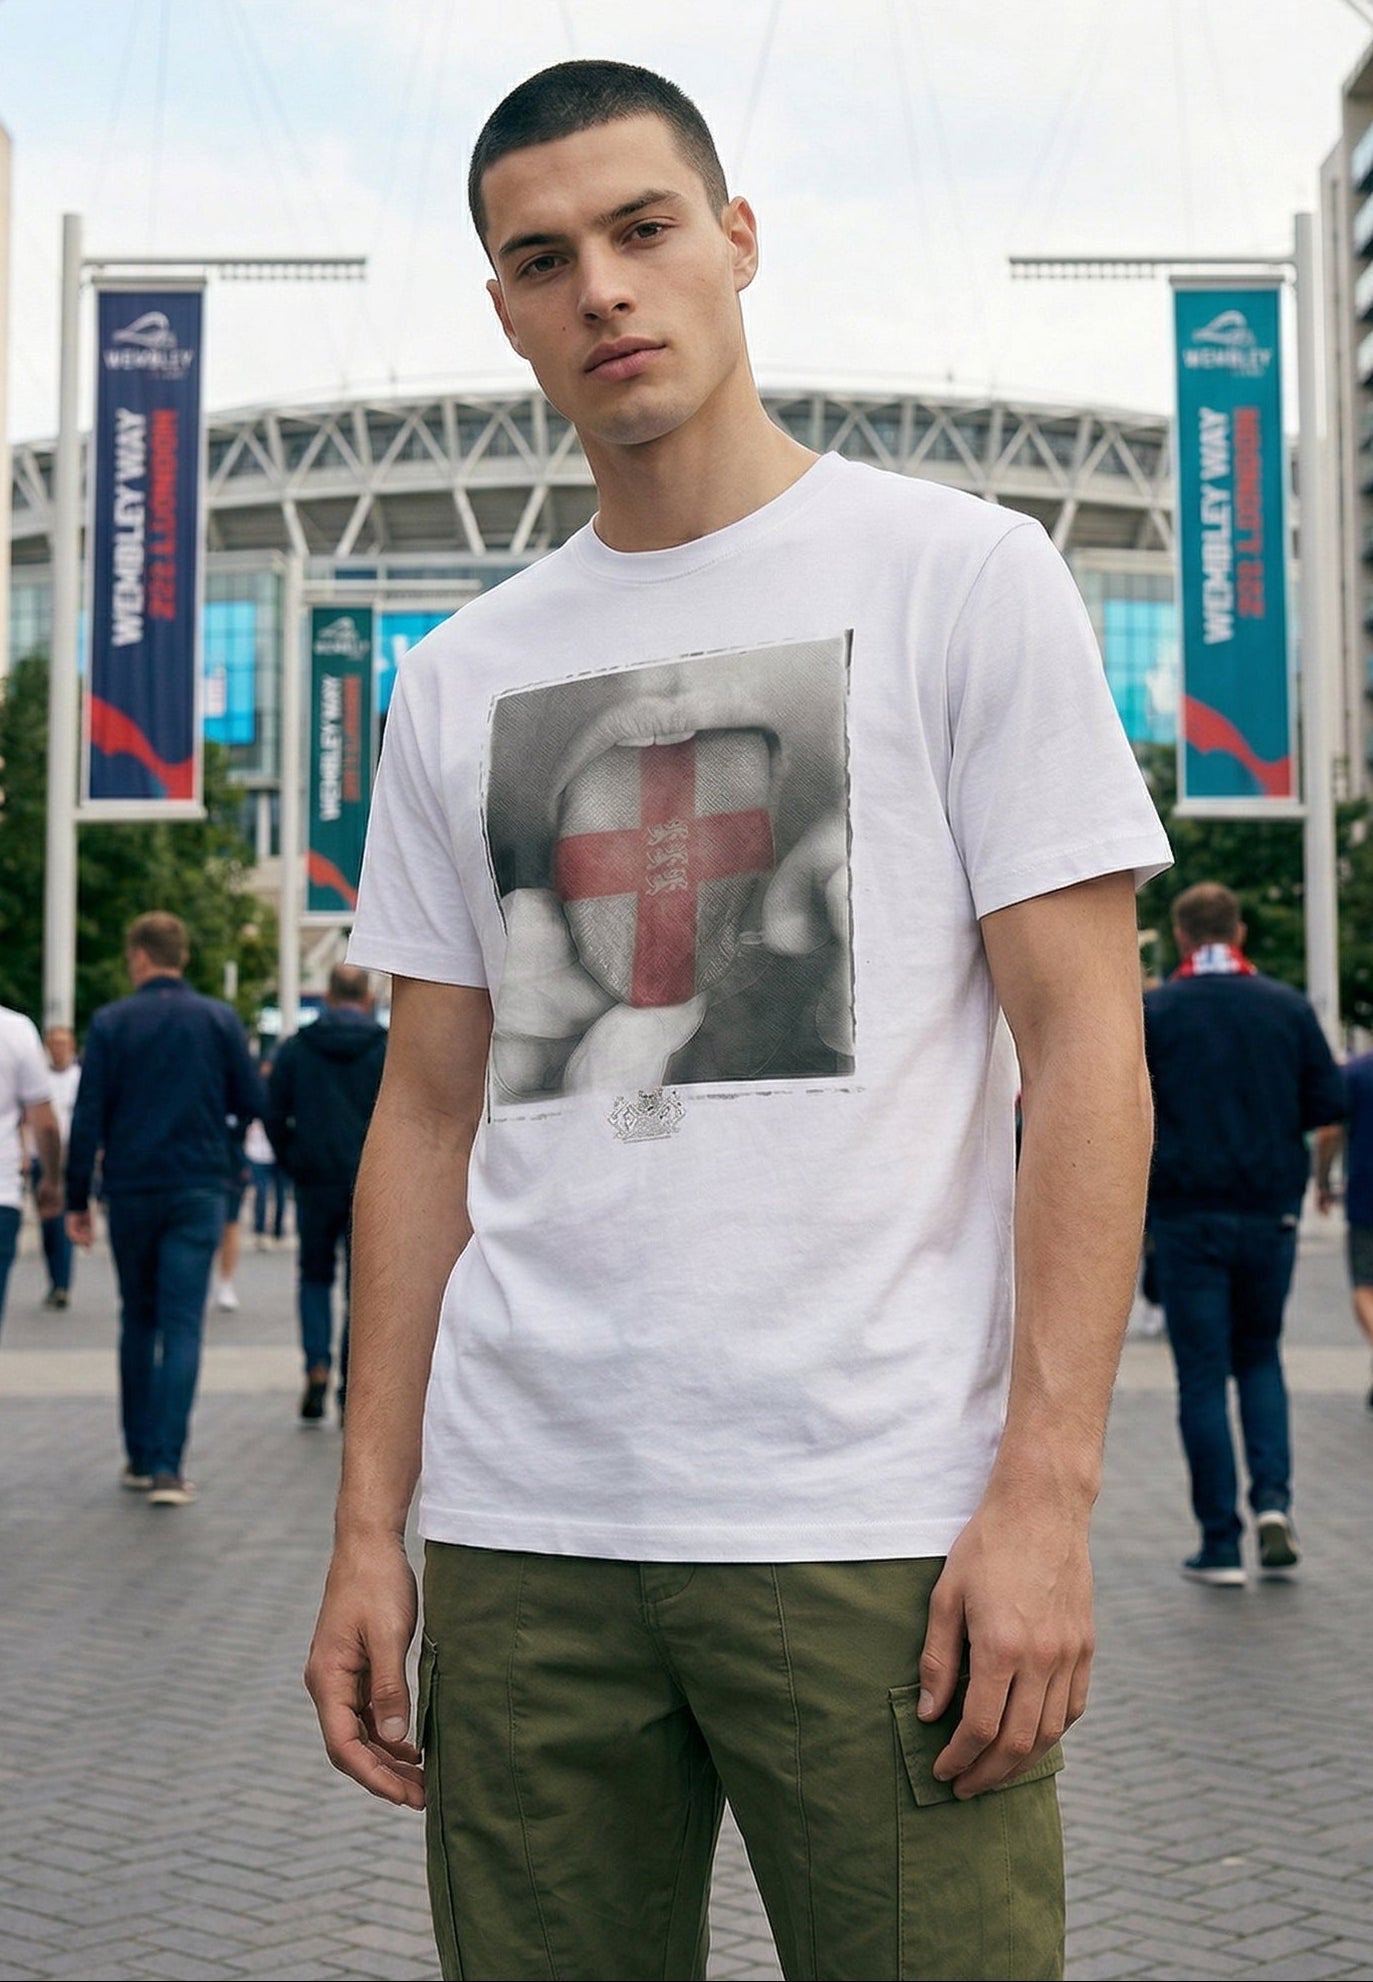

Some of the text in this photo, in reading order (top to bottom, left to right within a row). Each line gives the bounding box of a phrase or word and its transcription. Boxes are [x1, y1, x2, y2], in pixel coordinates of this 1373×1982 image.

[112, 407, 147, 647] WEMBLEY WAY
[1199, 406, 1234, 645] WEMBLEY WAY
